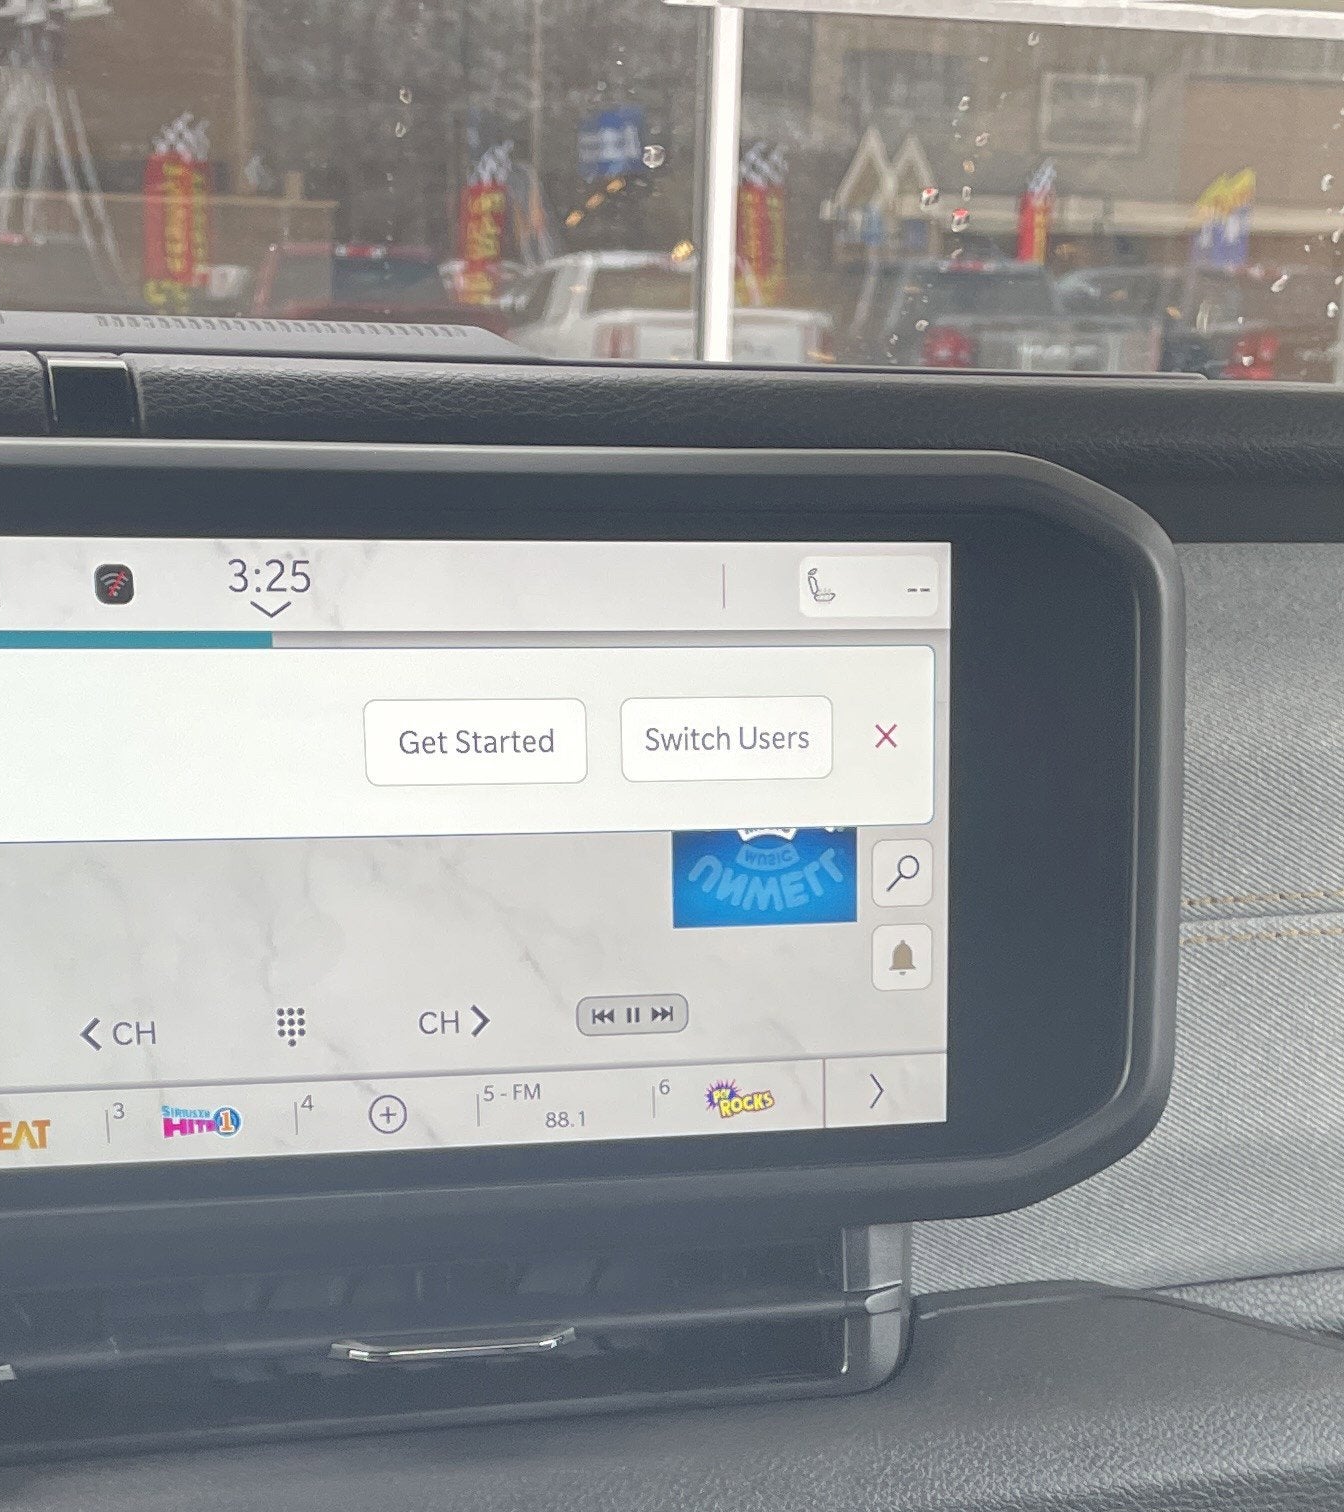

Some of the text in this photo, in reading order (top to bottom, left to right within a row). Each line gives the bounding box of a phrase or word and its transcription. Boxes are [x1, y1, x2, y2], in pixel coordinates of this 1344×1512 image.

[228, 557, 312, 594] 3:25
[398, 727, 555, 755] Get Started
[645, 726, 810, 752] Switch Users
[112, 1020, 157, 1046] CH
[418, 1010, 460, 1035] CH
[483, 1085, 495, 1102] 5
[512, 1083, 542, 1101] FM
[659, 1078, 671, 1096] 6
[112, 1101, 125, 1120] 3
[301, 1094, 314, 1112] 4
[719, 1091, 775, 1118] ROCKS
[545, 1110, 586, 1129] 88.1
